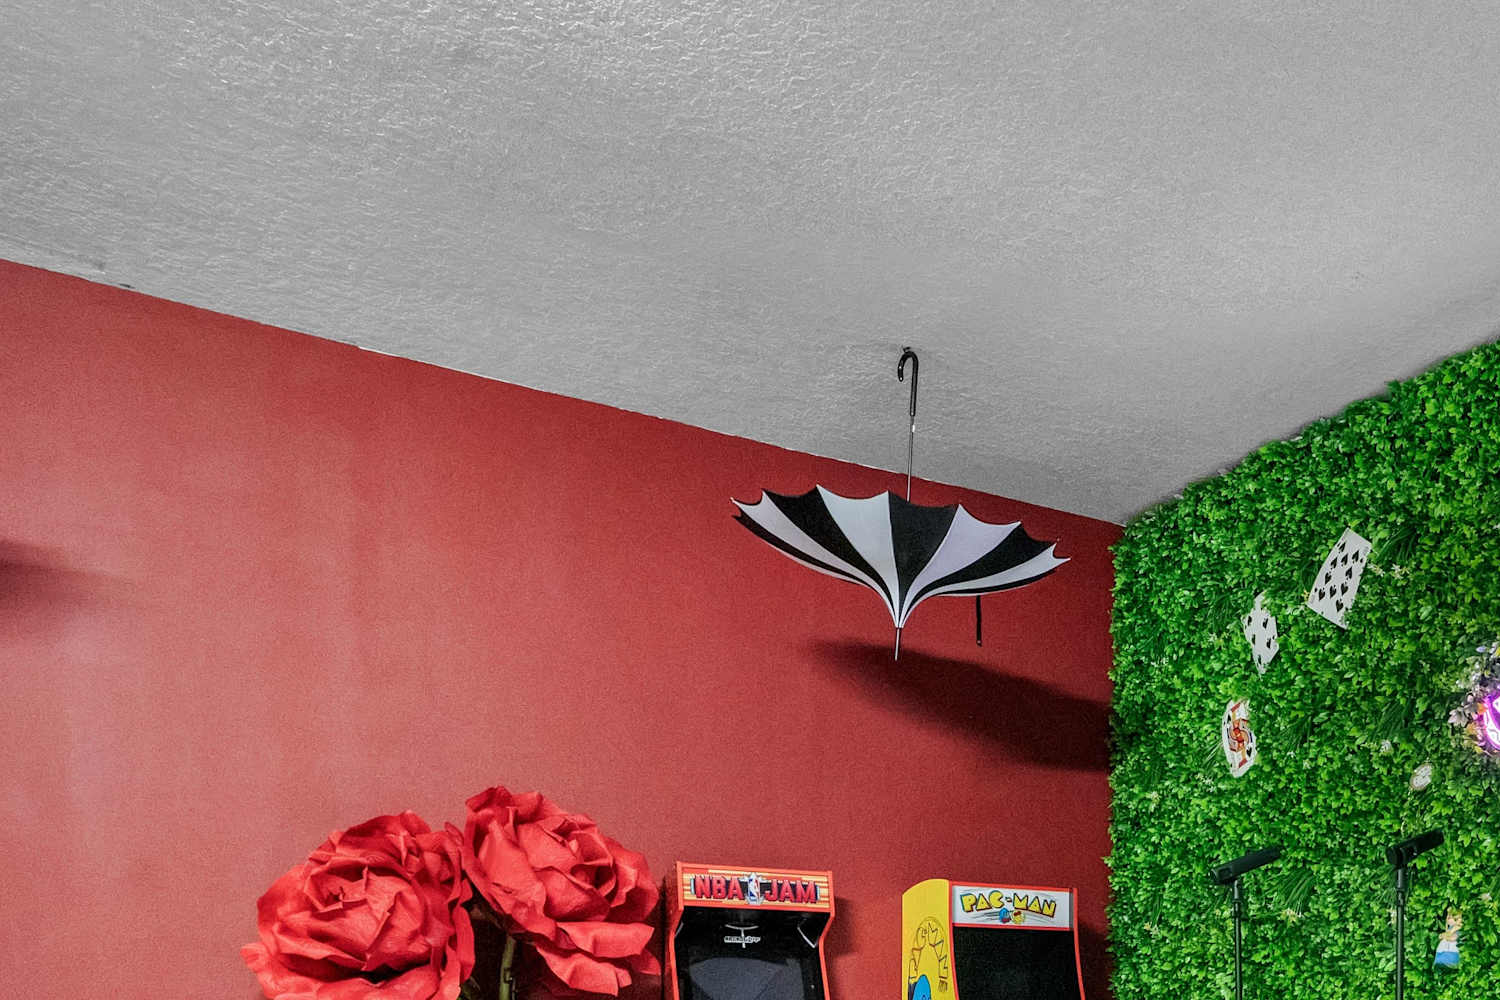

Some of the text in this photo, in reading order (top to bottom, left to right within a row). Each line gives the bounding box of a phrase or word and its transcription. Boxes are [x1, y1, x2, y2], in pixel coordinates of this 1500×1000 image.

[694, 874, 817, 904] NBA JAM
[960, 890, 1056, 918] PAC-MAN
